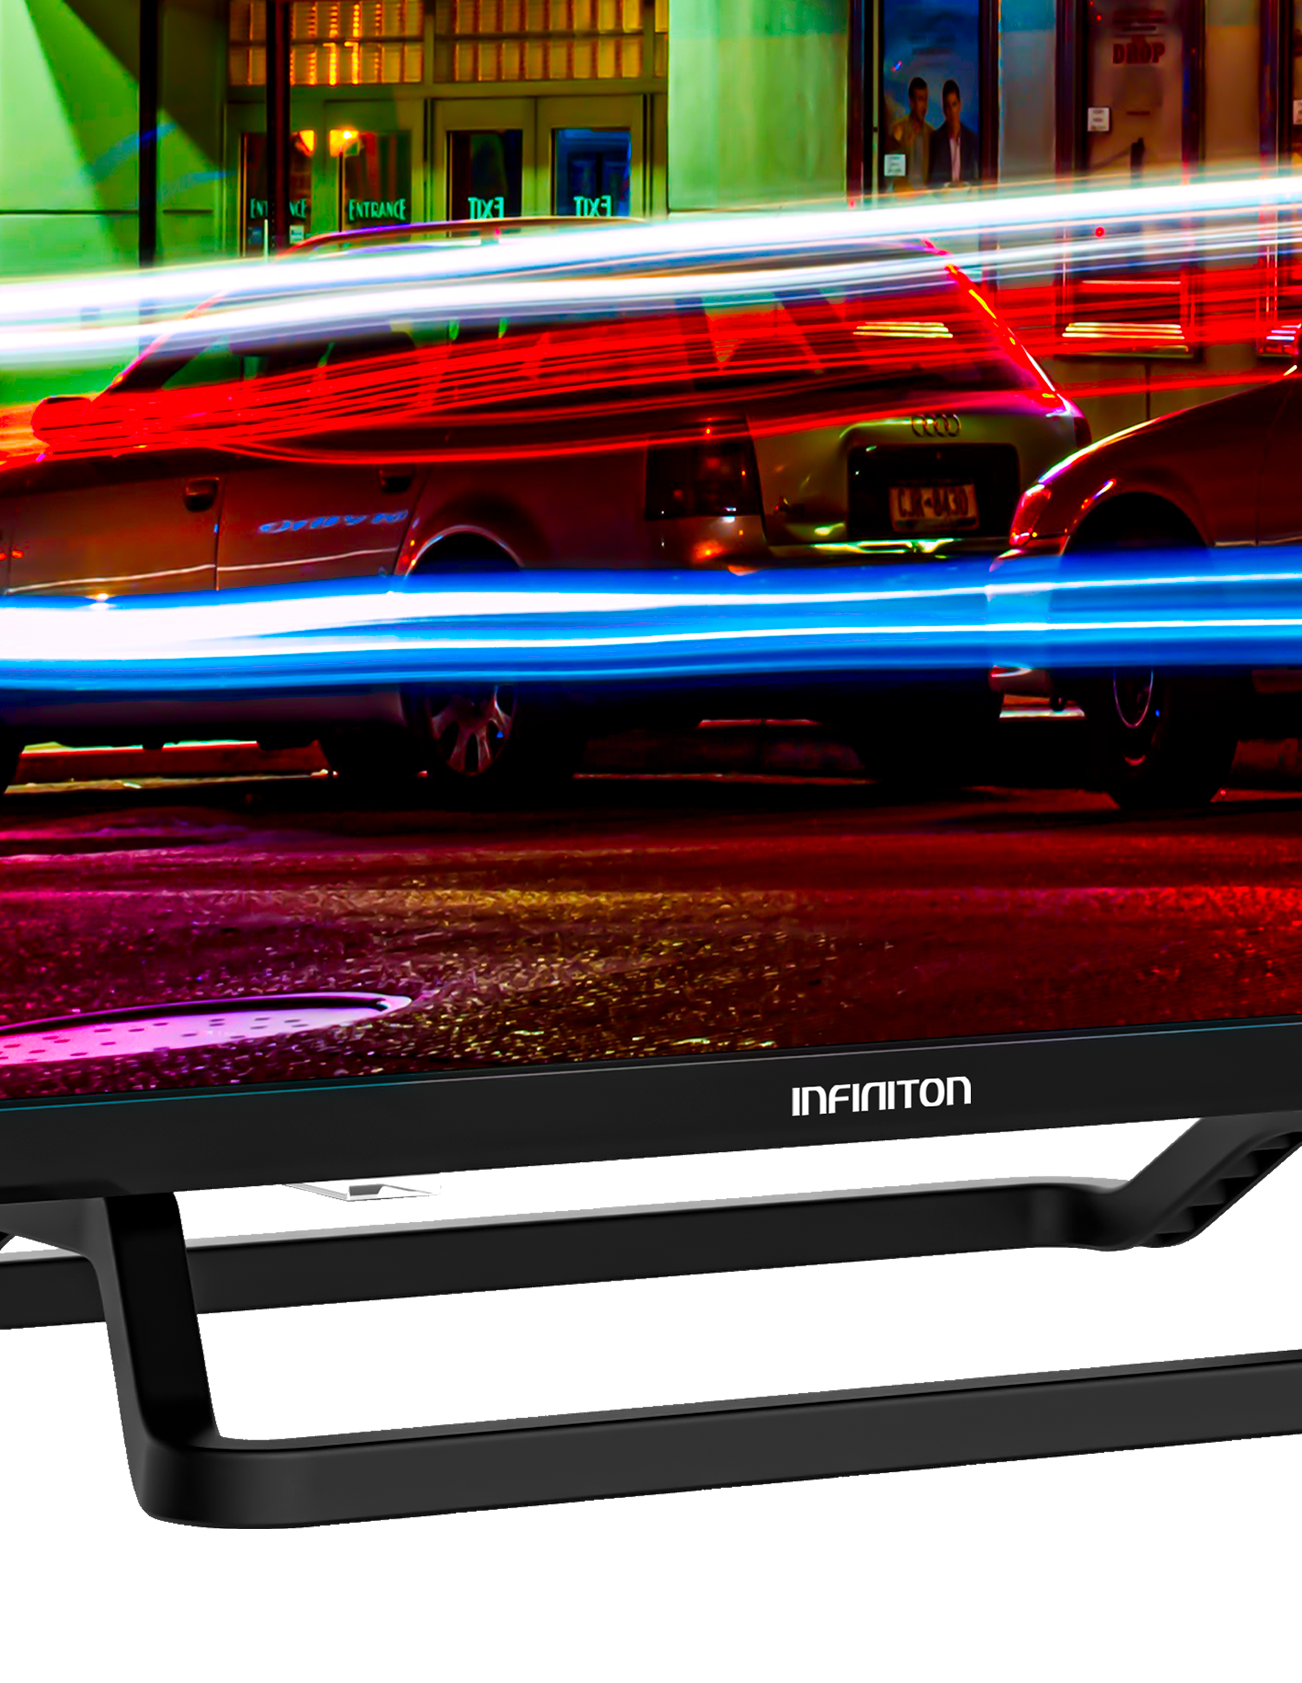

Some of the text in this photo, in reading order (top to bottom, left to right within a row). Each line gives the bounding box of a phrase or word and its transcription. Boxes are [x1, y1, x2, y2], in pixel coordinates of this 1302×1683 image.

[1113, 41, 1165, 64] DROP
[348, 198, 406, 221] ENTRANCE
[792, 1076, 972, 1117] INFINITON
